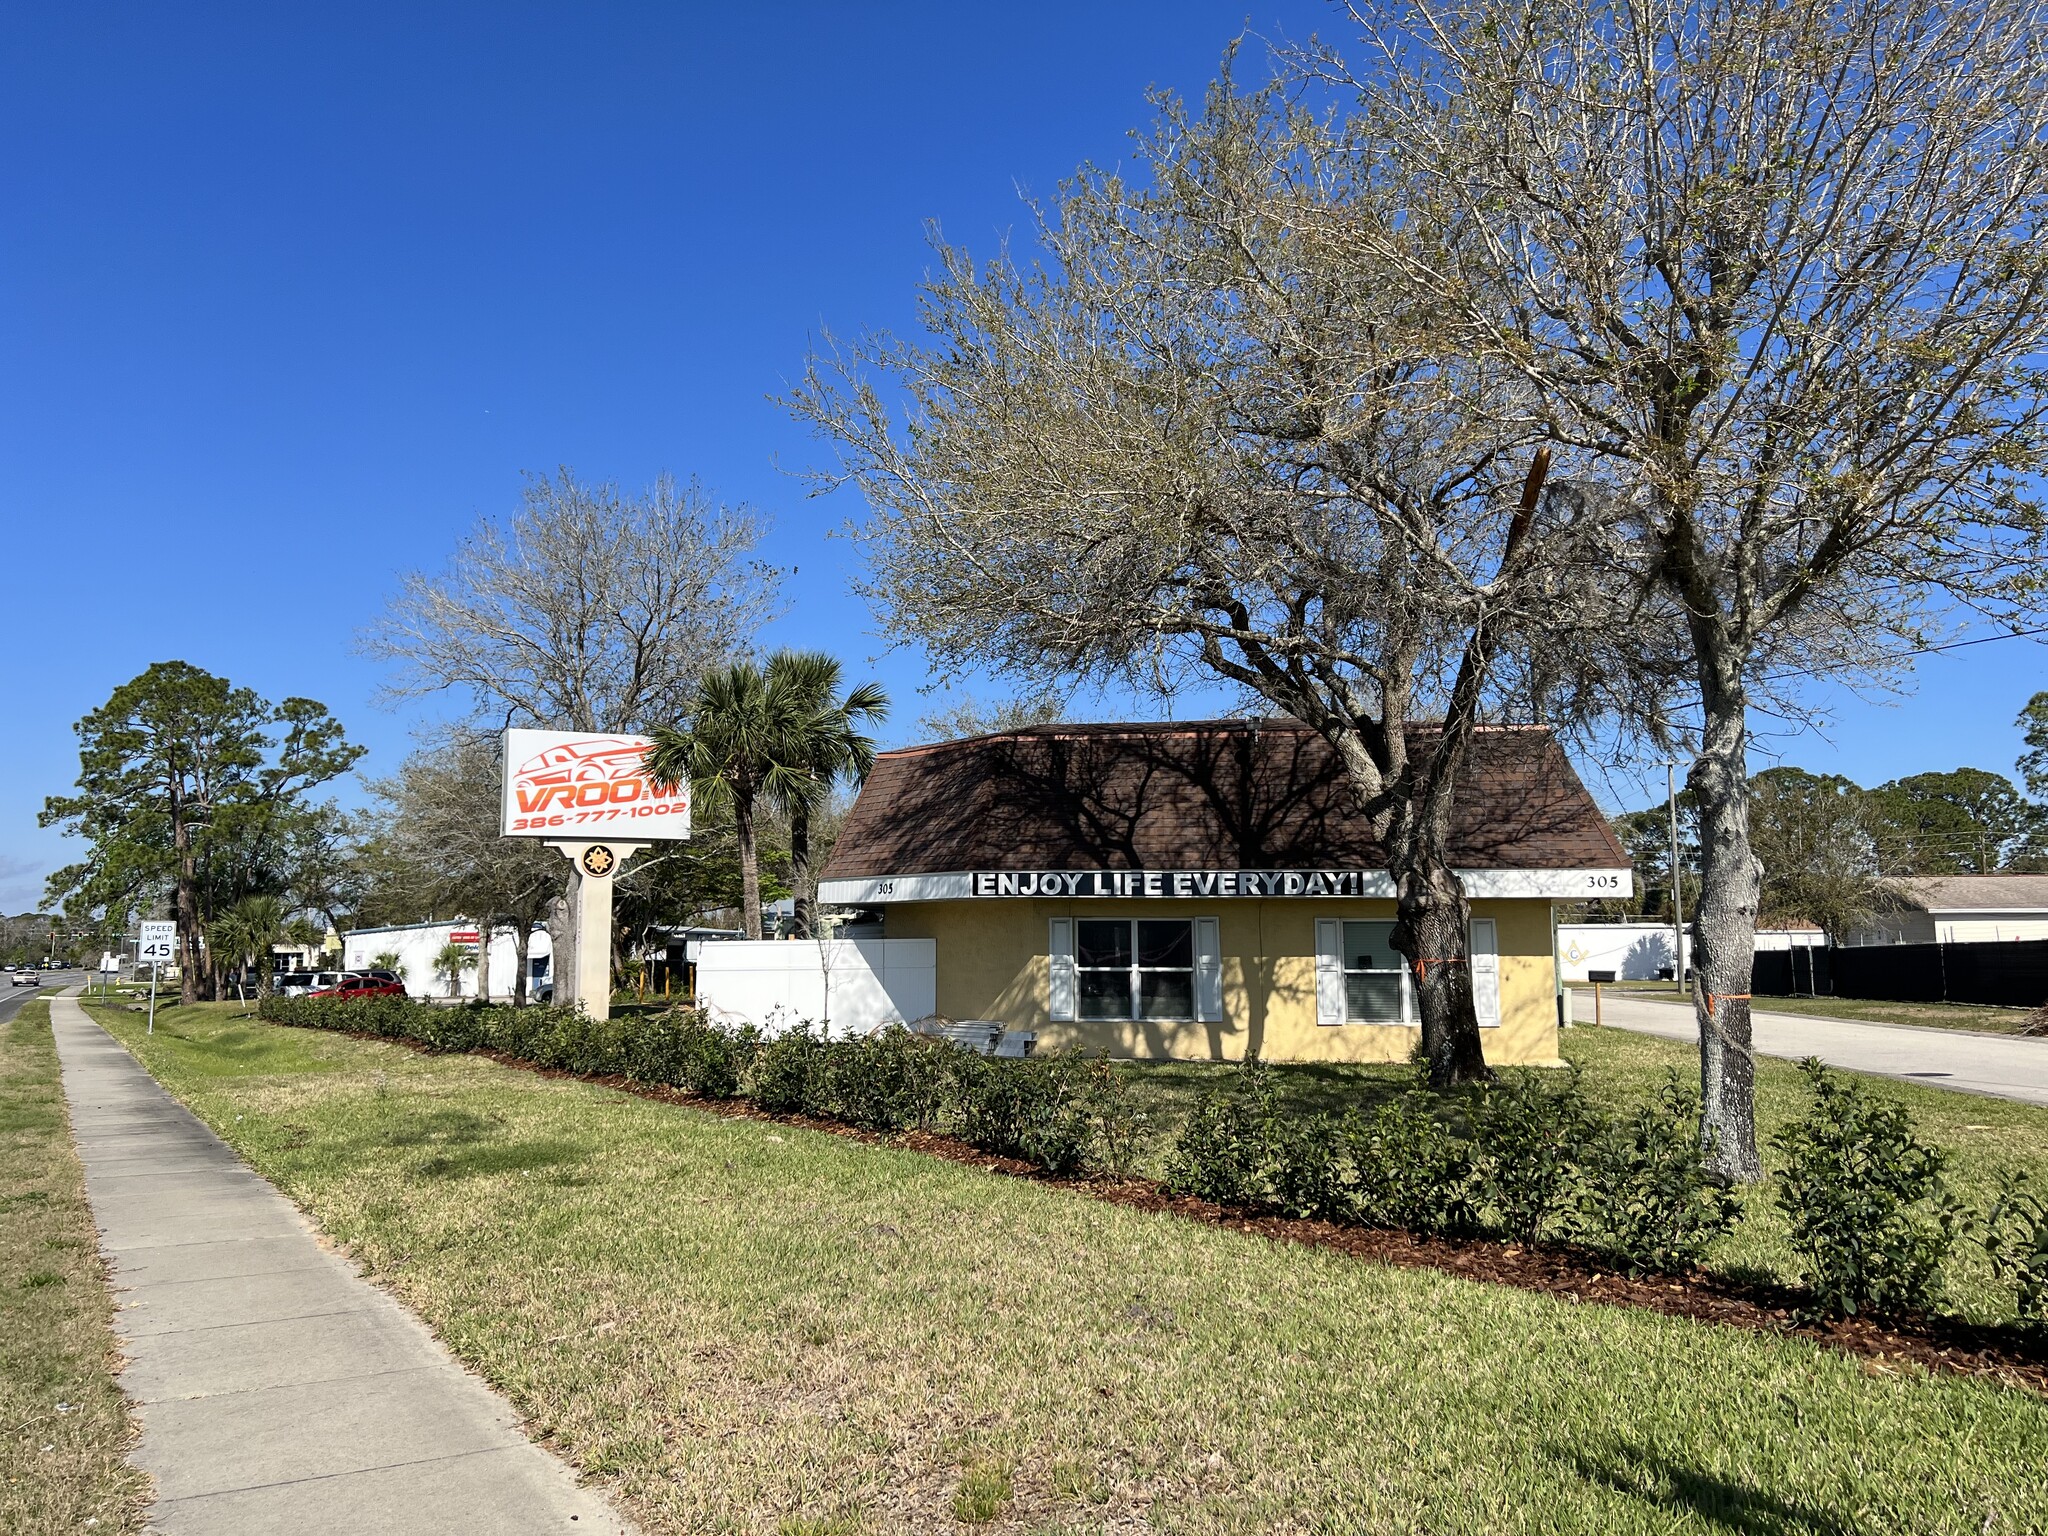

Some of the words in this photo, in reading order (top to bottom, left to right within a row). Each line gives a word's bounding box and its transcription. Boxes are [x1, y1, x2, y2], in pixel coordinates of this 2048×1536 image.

[511, 802, 687, 831] 386-777-1002
[976, 873, 1084, 896] ENJOY
[1093, 873, 1163, 896] LIFE
[1173, 872, 1360, 896] EVERYDAY!
[1587, 876, 1618, 888] 305
[877, 883, 893, 896] 305
[144, 944, 170, 956] 45
